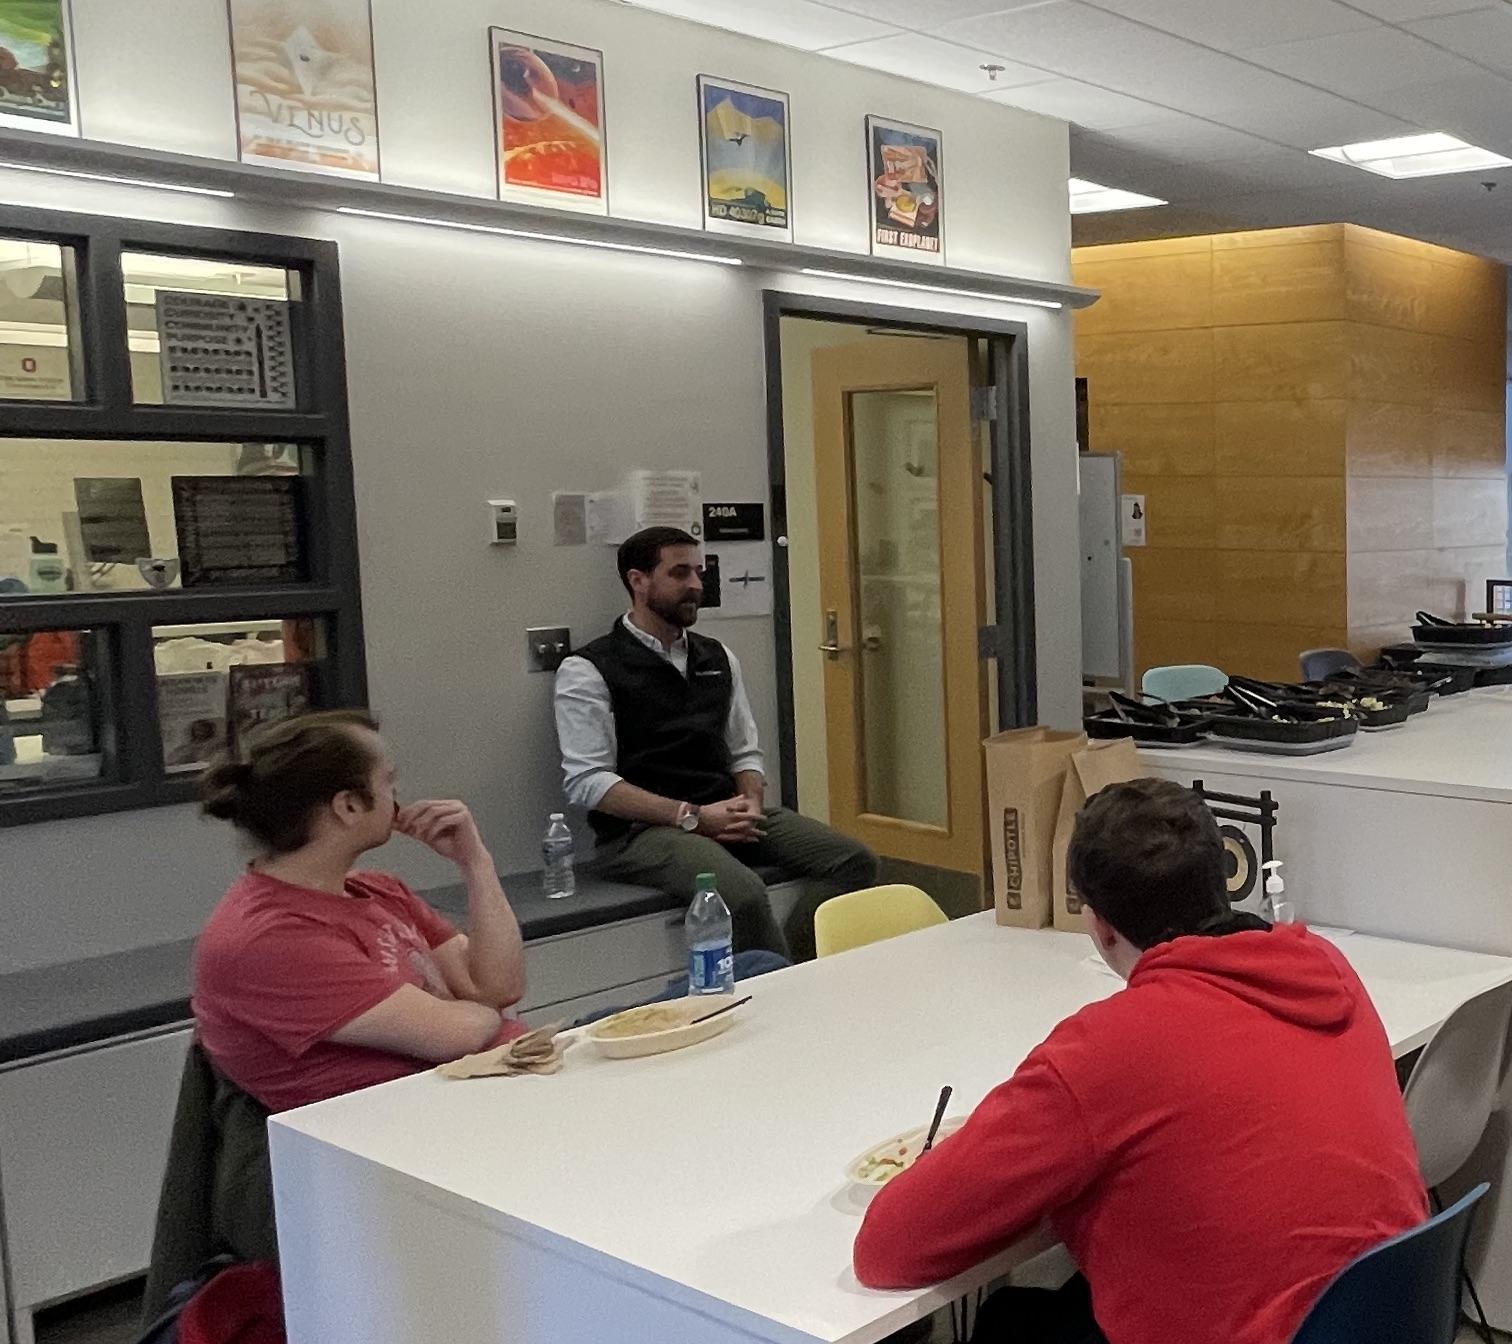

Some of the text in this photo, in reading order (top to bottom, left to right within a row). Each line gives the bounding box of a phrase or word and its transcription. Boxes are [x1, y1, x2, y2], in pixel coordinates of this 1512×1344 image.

[250, 90, 365, 146] VENUS
[877, 228, 938, 251] FIRST EXOPLANET
[708, 506, 737, 518] 240A
[1006, 811, 1020, 889] CHIPOTLE
